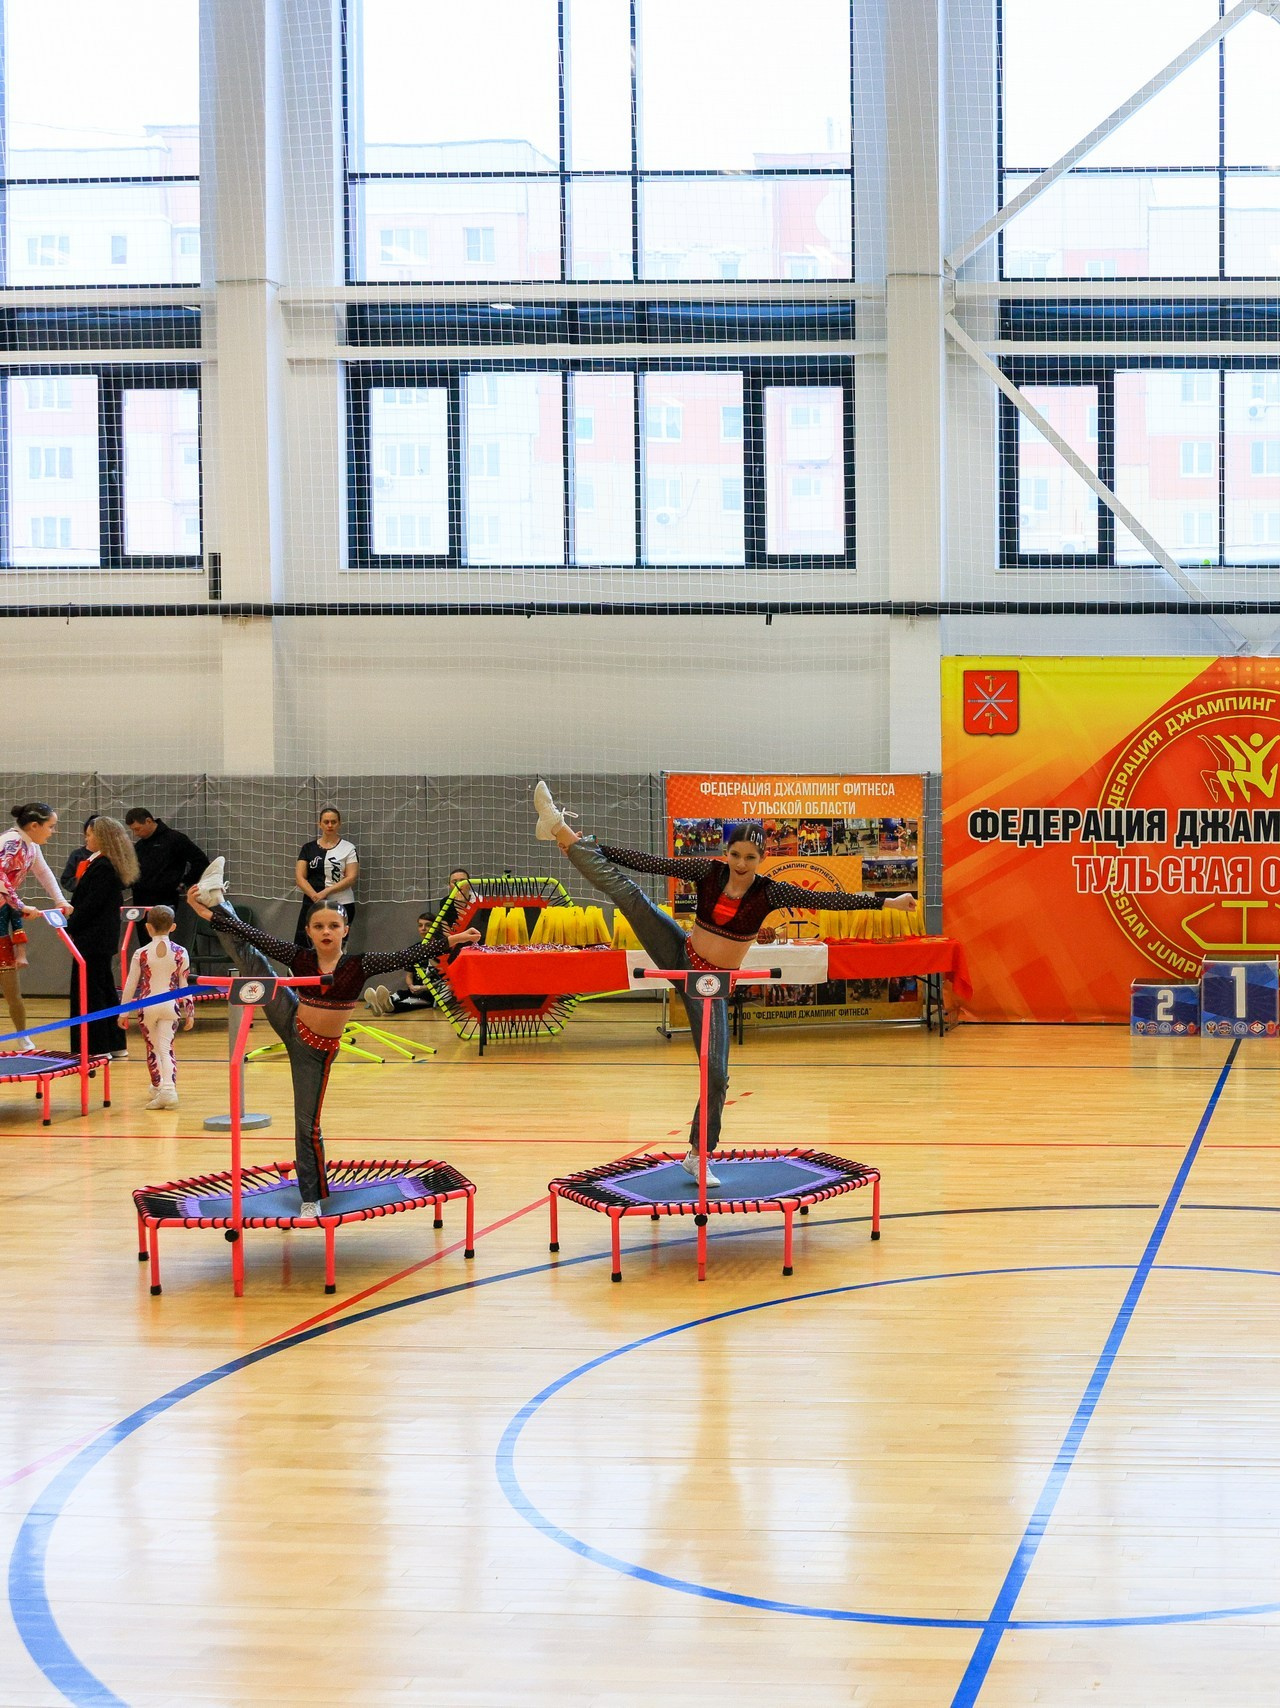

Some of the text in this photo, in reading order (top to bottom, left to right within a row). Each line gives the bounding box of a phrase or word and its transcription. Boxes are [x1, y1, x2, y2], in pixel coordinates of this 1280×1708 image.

[1107, 729, 1163, 809] ДЕРАЦИЯ
[1164, 696, 1276, 735] ДЖАМПИНГ
[700, 782, 895, 797] ФЕДЕРАЦИЯ ДЖАМПИНГ ФИТНЕСА
[742, 799, 856, 815] ТУЛЬСКОЙ ОБЛАСТИ
[968, 808, 1167, 848] ФЕДЕРАЦИЯ
[772, 863, 835, 883] ДЖАМПИНГ ФИТНЕСА
[1072, 856, 1252, 893] ТУЛЬСКАЯ
[1147, 940, 1200, 978] JUMPI
[1157, 989, 1174, 1021] 2
[1231, 966, 1246, 1019] 1
[728, 1008, 872, 1021] ООО "ФЕДЕРАЦИЯ ДЖАМПИНГ ФИТНЕСА"
